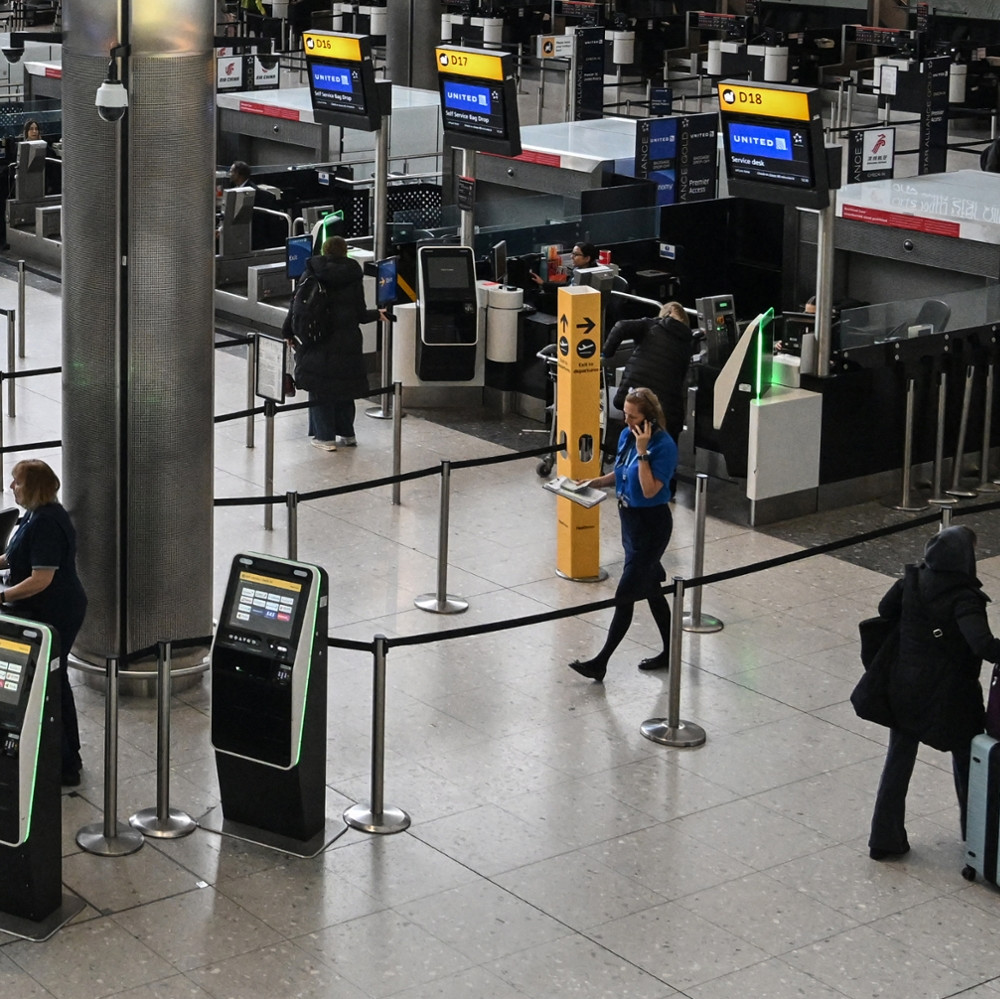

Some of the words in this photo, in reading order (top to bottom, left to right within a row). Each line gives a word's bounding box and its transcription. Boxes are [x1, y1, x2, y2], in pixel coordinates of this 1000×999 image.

[316, 40, 331, 49] D16
[451, 55, 467, 66] D17
[314, 74, 340, 82] UNITED
[447, 92, 477, 102] UNITED
[739, 92, 762, 104] D18
[733, 135, 774, 147] UNITED
[731, 156, 751, 164] Service
[752, 158, 765, 166] desk
[854, 147, 862, 182] ANCE
